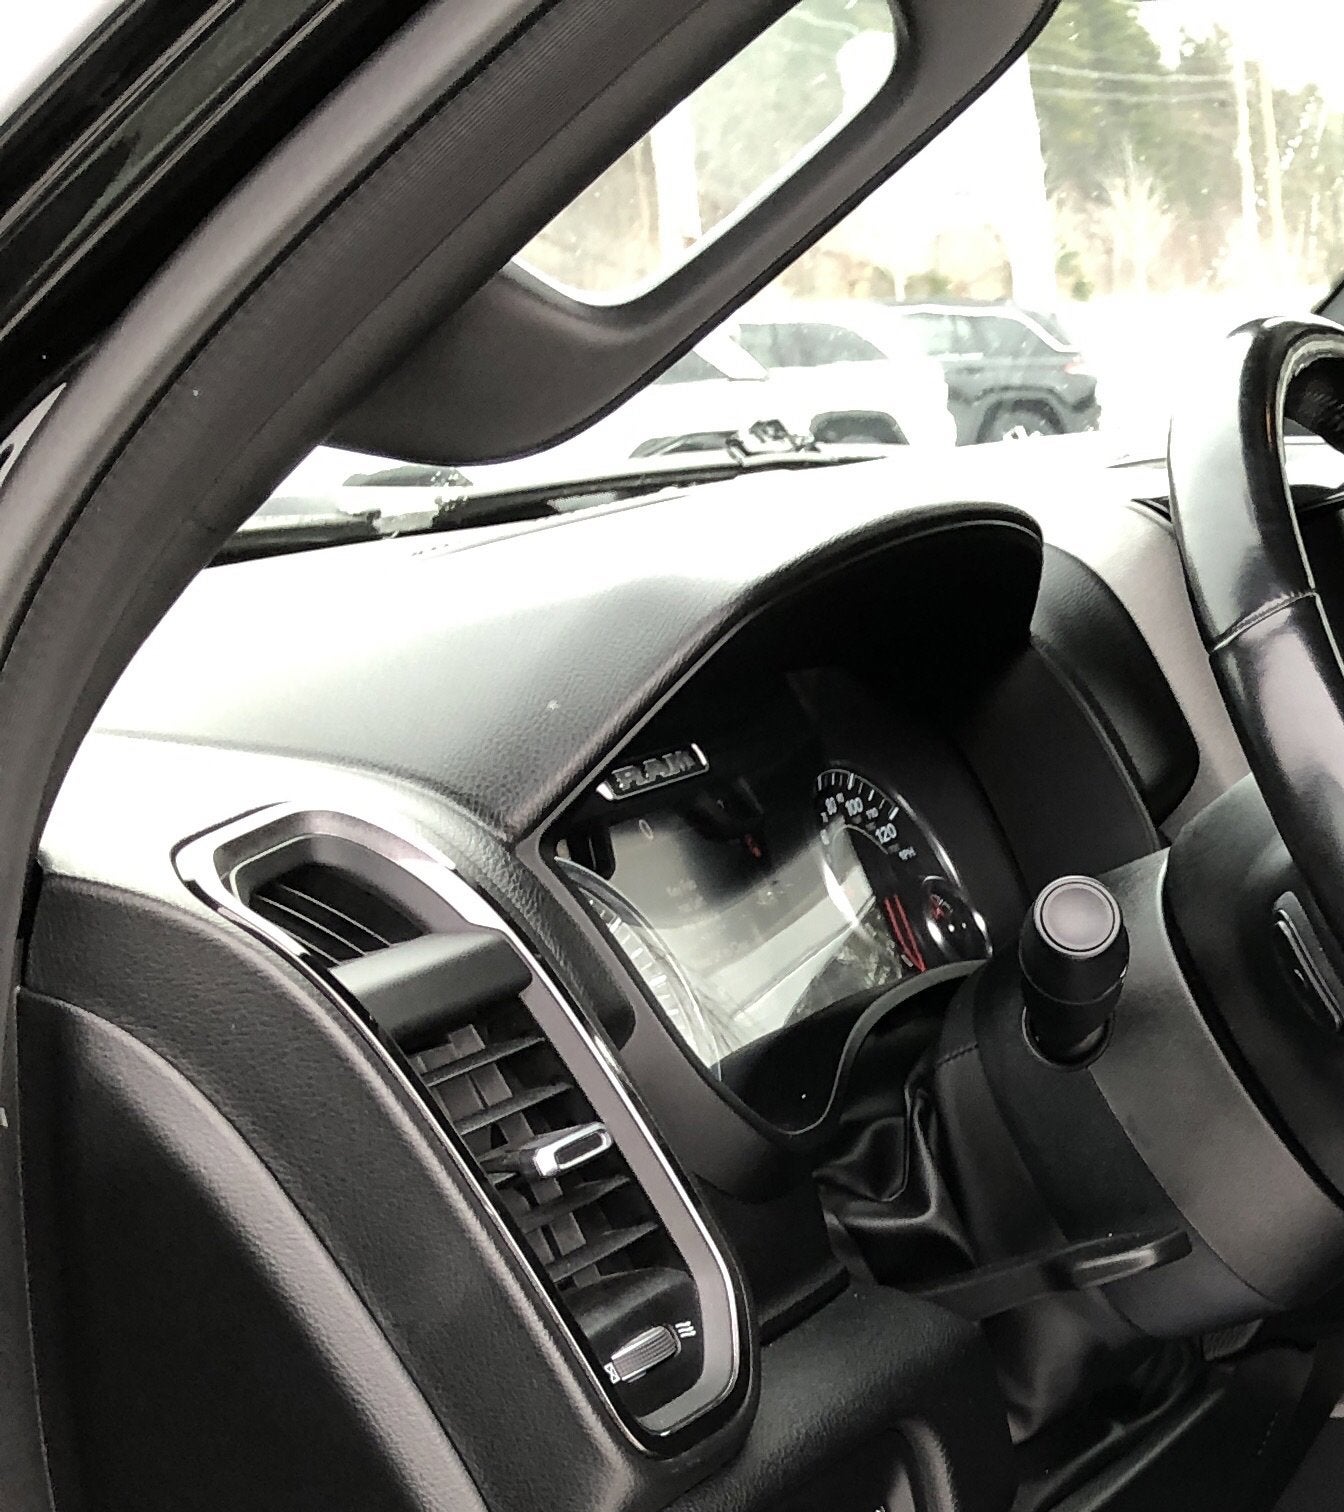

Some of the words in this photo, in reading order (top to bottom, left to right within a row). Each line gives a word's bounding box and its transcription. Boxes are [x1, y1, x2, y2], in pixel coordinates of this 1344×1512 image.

[611, 750, 696, 791] RAM
[845, 797, 864, 816] 100
[875, 822, 898, 845] 120
